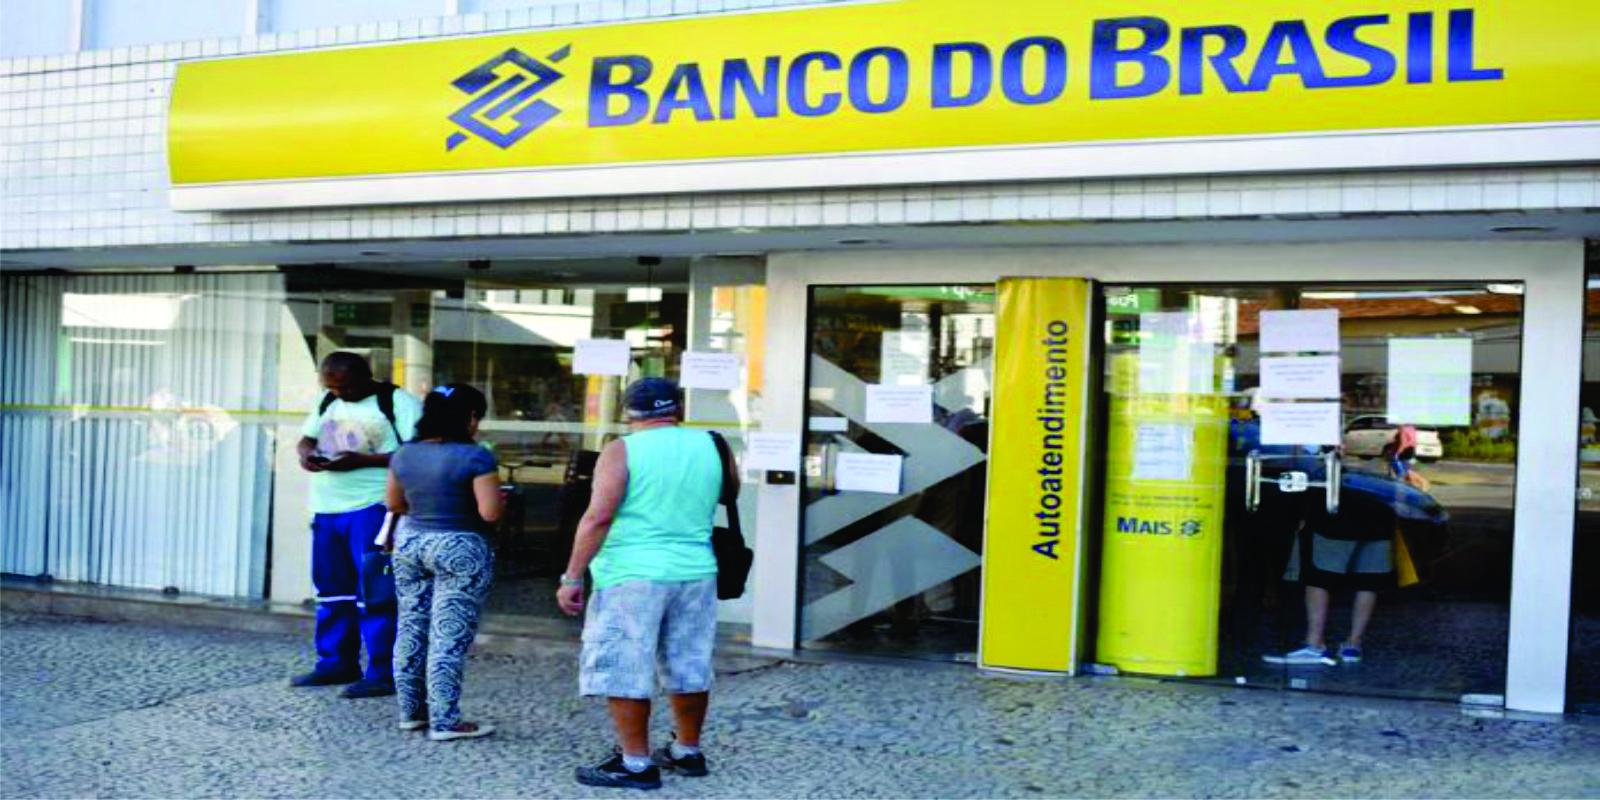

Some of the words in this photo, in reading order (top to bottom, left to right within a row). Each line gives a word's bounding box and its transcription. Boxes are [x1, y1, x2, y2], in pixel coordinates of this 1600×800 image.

[588, 46, 909, 128] BANCO
[931, 35, 1067, 109] DO
[1089, 8, 1504, 100] BRASIL
[1031, 319, 1069, 561] Autoatendimento
[1117, 516, 1172, 535] MAIS
